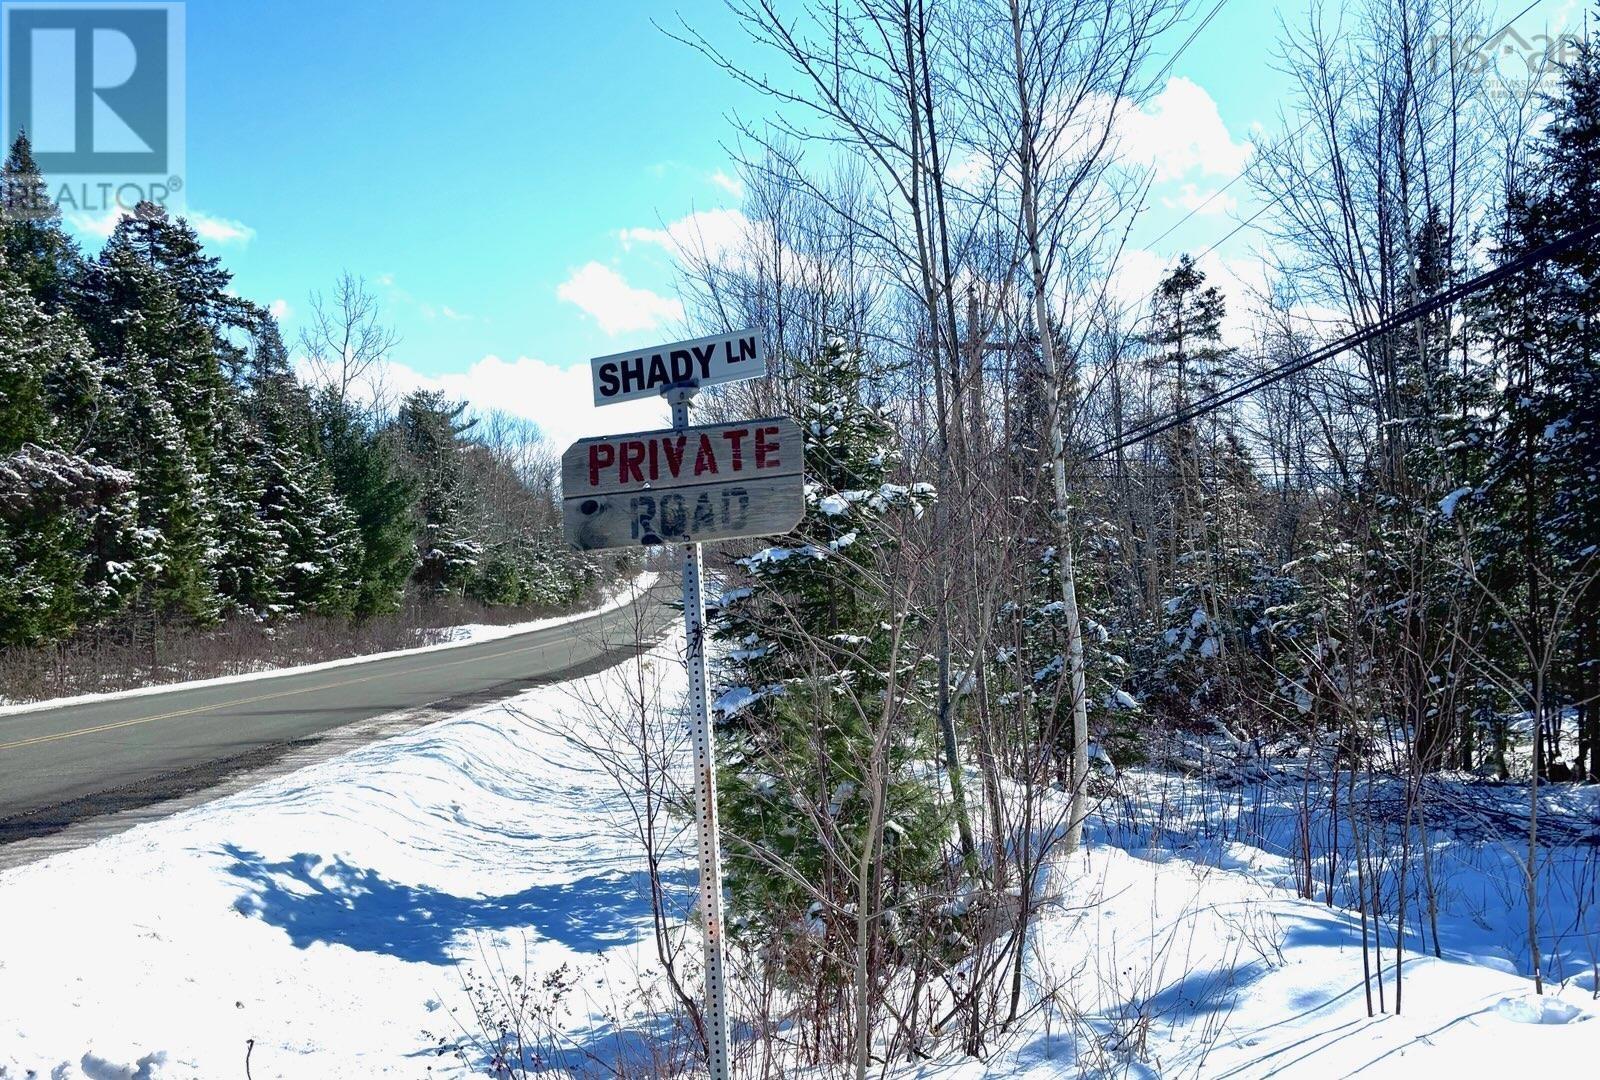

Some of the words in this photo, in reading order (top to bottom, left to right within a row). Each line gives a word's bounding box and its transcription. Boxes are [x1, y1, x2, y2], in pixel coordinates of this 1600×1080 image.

[599, 344, 715, 396] SHADY
[726, 337, 757, 364] LN
[588, 427, 781, 486] PRIVATE
[630, 487, 749, 538] ROAD
